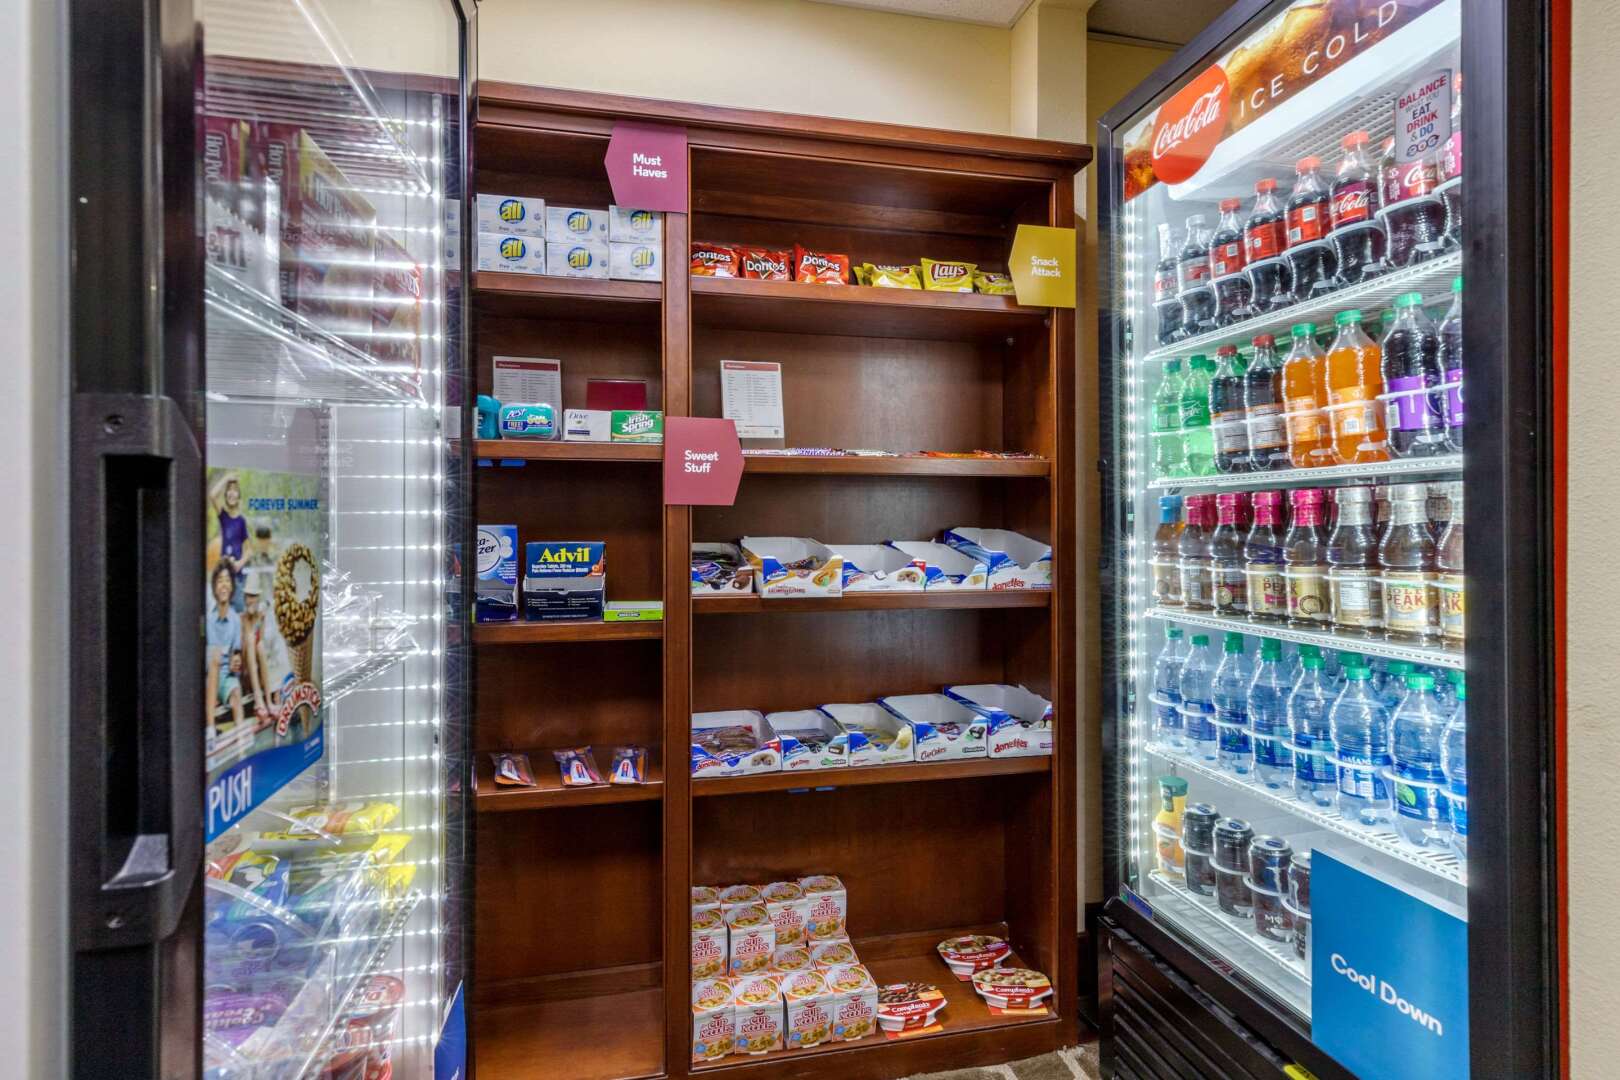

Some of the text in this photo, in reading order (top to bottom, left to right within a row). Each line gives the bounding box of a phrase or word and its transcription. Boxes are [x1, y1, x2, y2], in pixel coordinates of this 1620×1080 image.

[1240, 1, 1398, 118] ICE COLD
[1398, 75, 1447, 109] BALANCE
[1412, 102, 1431, 119] EAT
[1153, 82, 1224, 160] Coca-Cola
[1406, 109, 1439, 133] DRINK
[1419, 123, 1434, 138] DO
[632, 153, 662, 166] Must
[632, 165, 668, 179] Haves
[501, 202, 522, 220] all
[569, 214, 589, 231] all
[501, 239, 523, 257] all
[569, 249, 589, 267] all
[631, 248, 652, 266] all
[803, 255, 841, 271] Doritos
[1031, 255, 1059, 267] Snack
[746, 258, 785, 272] Doritos
[1031, 267, 1062, 278] Attack
[621, 418, 654, 433] Spring
[628, 414, 649, 425] Irish
[684, 450, 719, 462] Sweet
[684, 462, 711, 473] Stuff
[248, 498, 319, 511] FOREVER SUMMER
[538, 547, 592, 563] Advil
[1387, 593, 1424, 607] PEAK
[994, 738, 1029, 753] donettes
[208, 765, 252, 834] PUSH
[818, 901, 833, 910] CUP
[744, 936, 763, 946] CUP
[1330, 953, 1443, 1036] Cool Down
[802, 1007, 821, 1017] CUP
[847, 1000, 865, 1010] CUP
[709, 1018, 728, 1029] CUP
[751, 1015, 771, 1025] CUP
